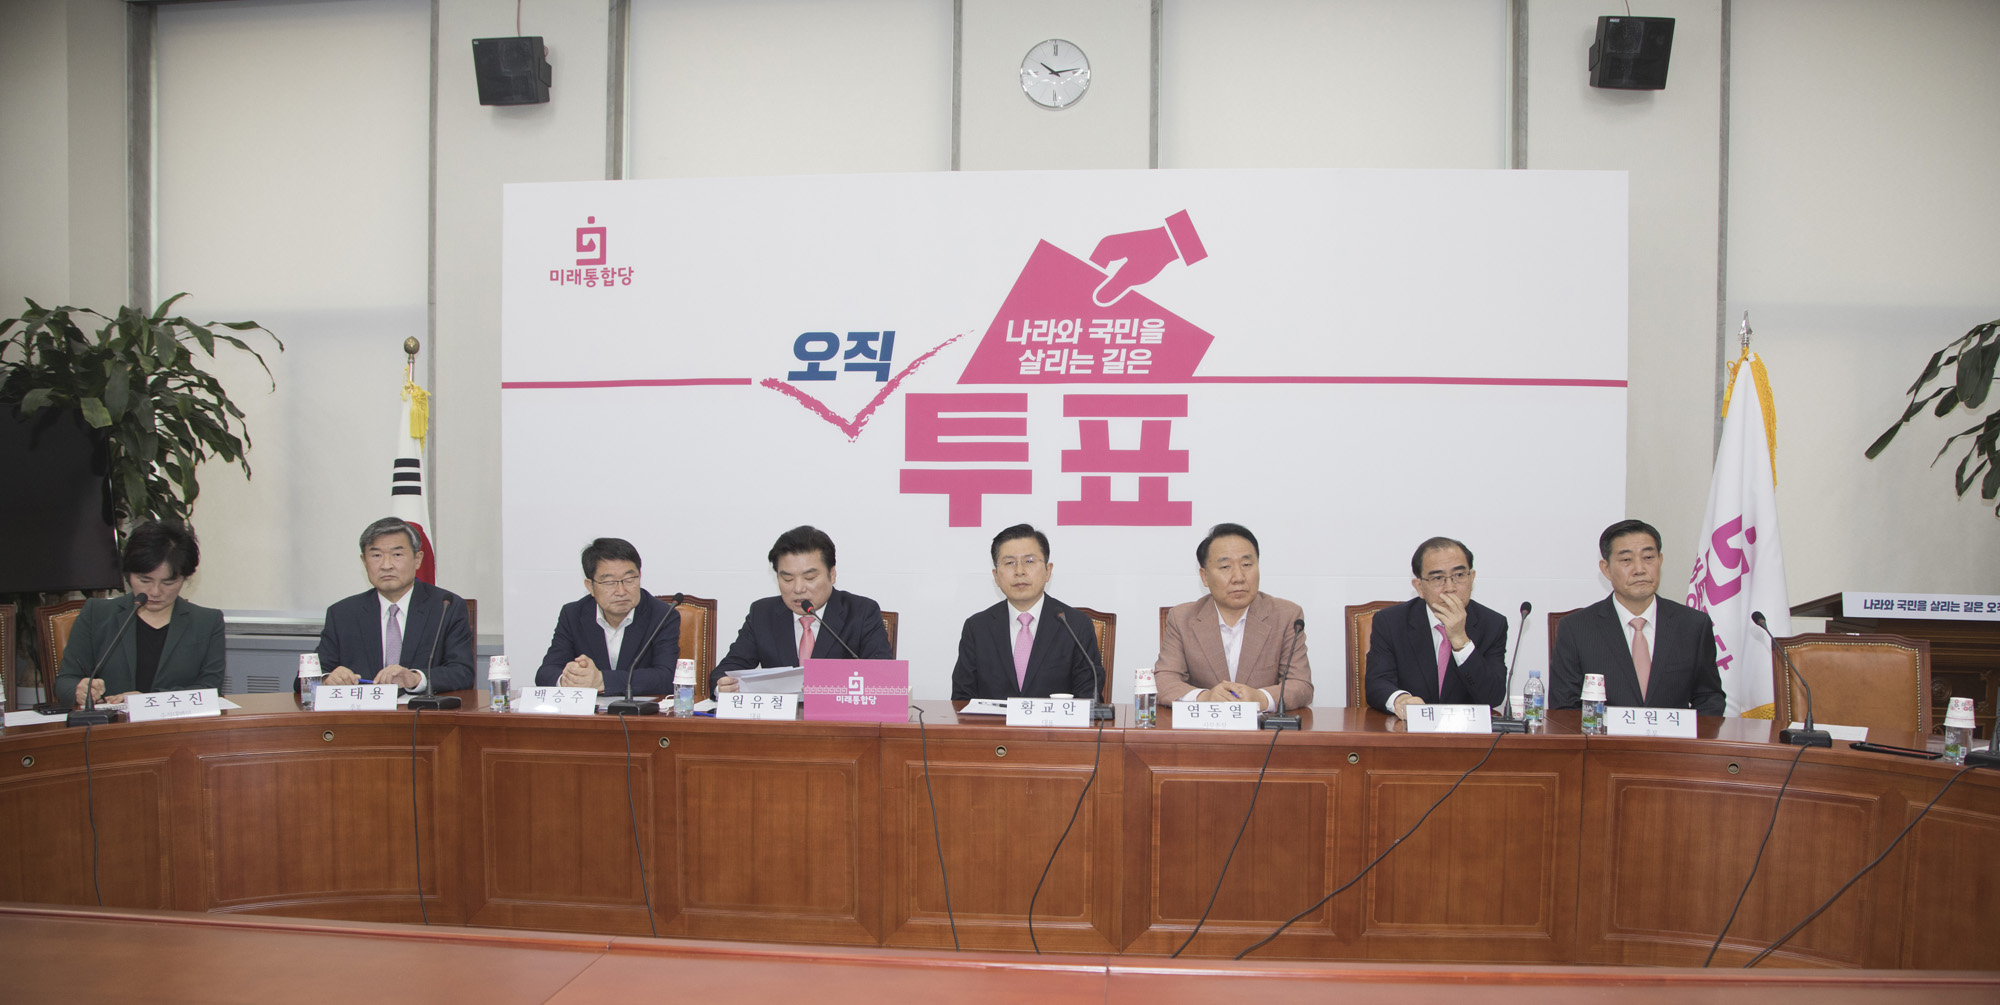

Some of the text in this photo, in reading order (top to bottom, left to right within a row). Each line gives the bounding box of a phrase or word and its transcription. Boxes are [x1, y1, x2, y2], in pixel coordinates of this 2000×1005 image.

[550, 266, 634, 288] 미래통합당
[1005, 318, 1165, 345] 나라와 국민을
[787, 330, 896, 382] 오직
[1018, 348, 1152, 375] 살리는 길은
[899, 393, 1193, 527] 투표
[1863, 599, 1894, 611] 나라와
[1897, 600, 1927, 611] 국민을
[1930, 601, 1960, 612] 살리는
[1963, 601, 1983, 613] 길은
[144, 691, 203, 708] 조수진
[329, 686, 384, 700] 조태용
[534, 689, 584, 703] 백승주
[836, 695, 877, 705] 미래통합당
[731, 694, 784, 710] 원유철
[1020, 700, 1076, 716] 황교안
[1187, 703, 1242, 719] 염동열
[1622, 709, 1680, 727] 신원식
